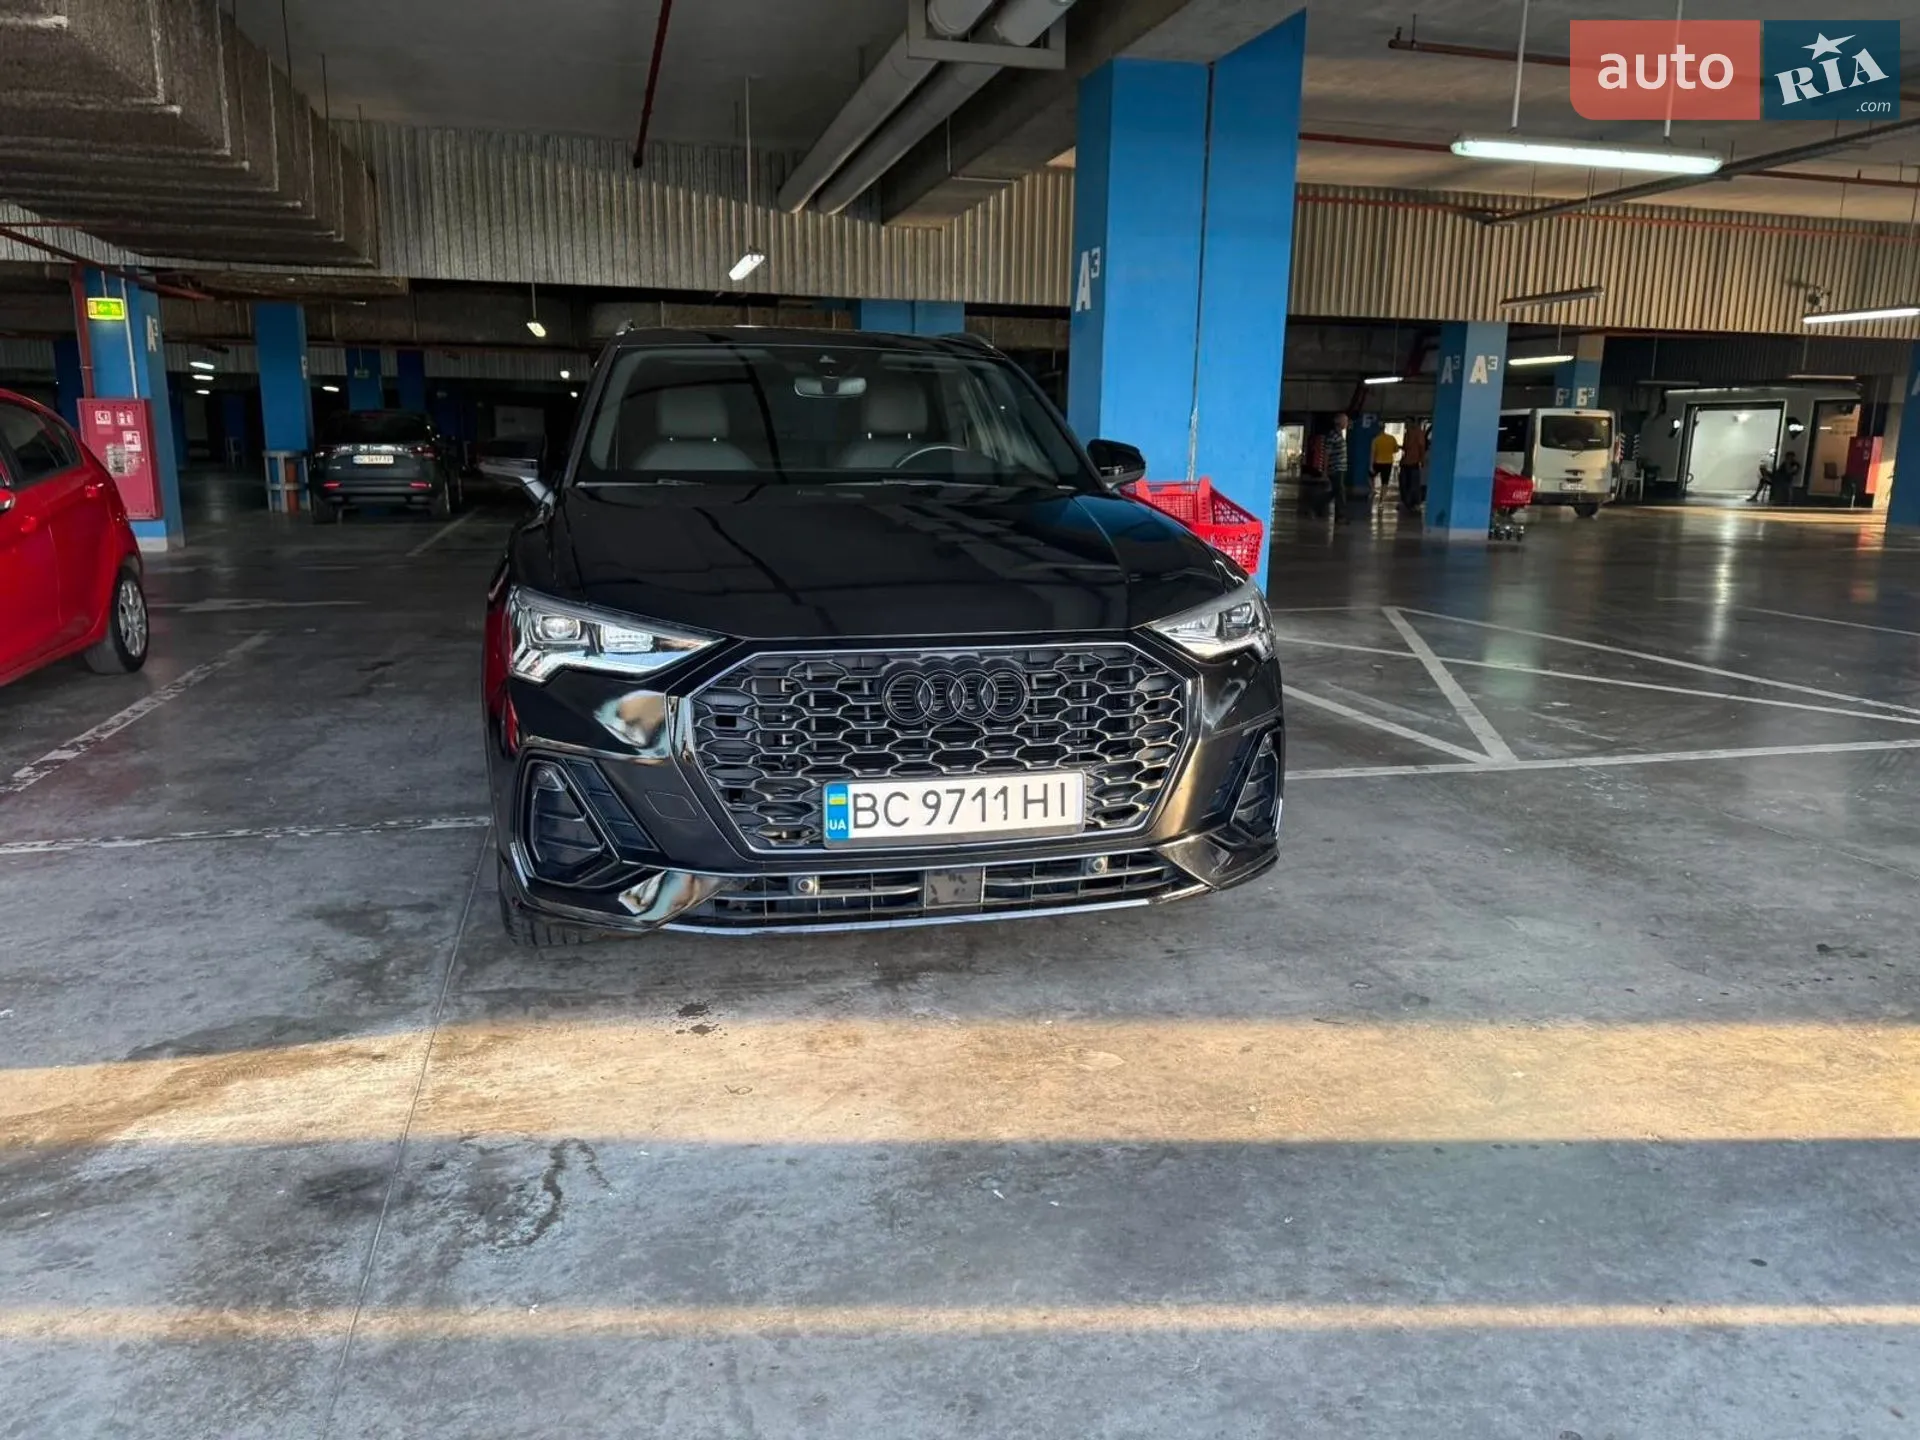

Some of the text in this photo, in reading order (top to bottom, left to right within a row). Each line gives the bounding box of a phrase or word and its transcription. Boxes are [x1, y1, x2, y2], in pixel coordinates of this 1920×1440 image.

[853, 782, 1066, 829] BC 9711 HI
[829, 819, 847, 831] UA
